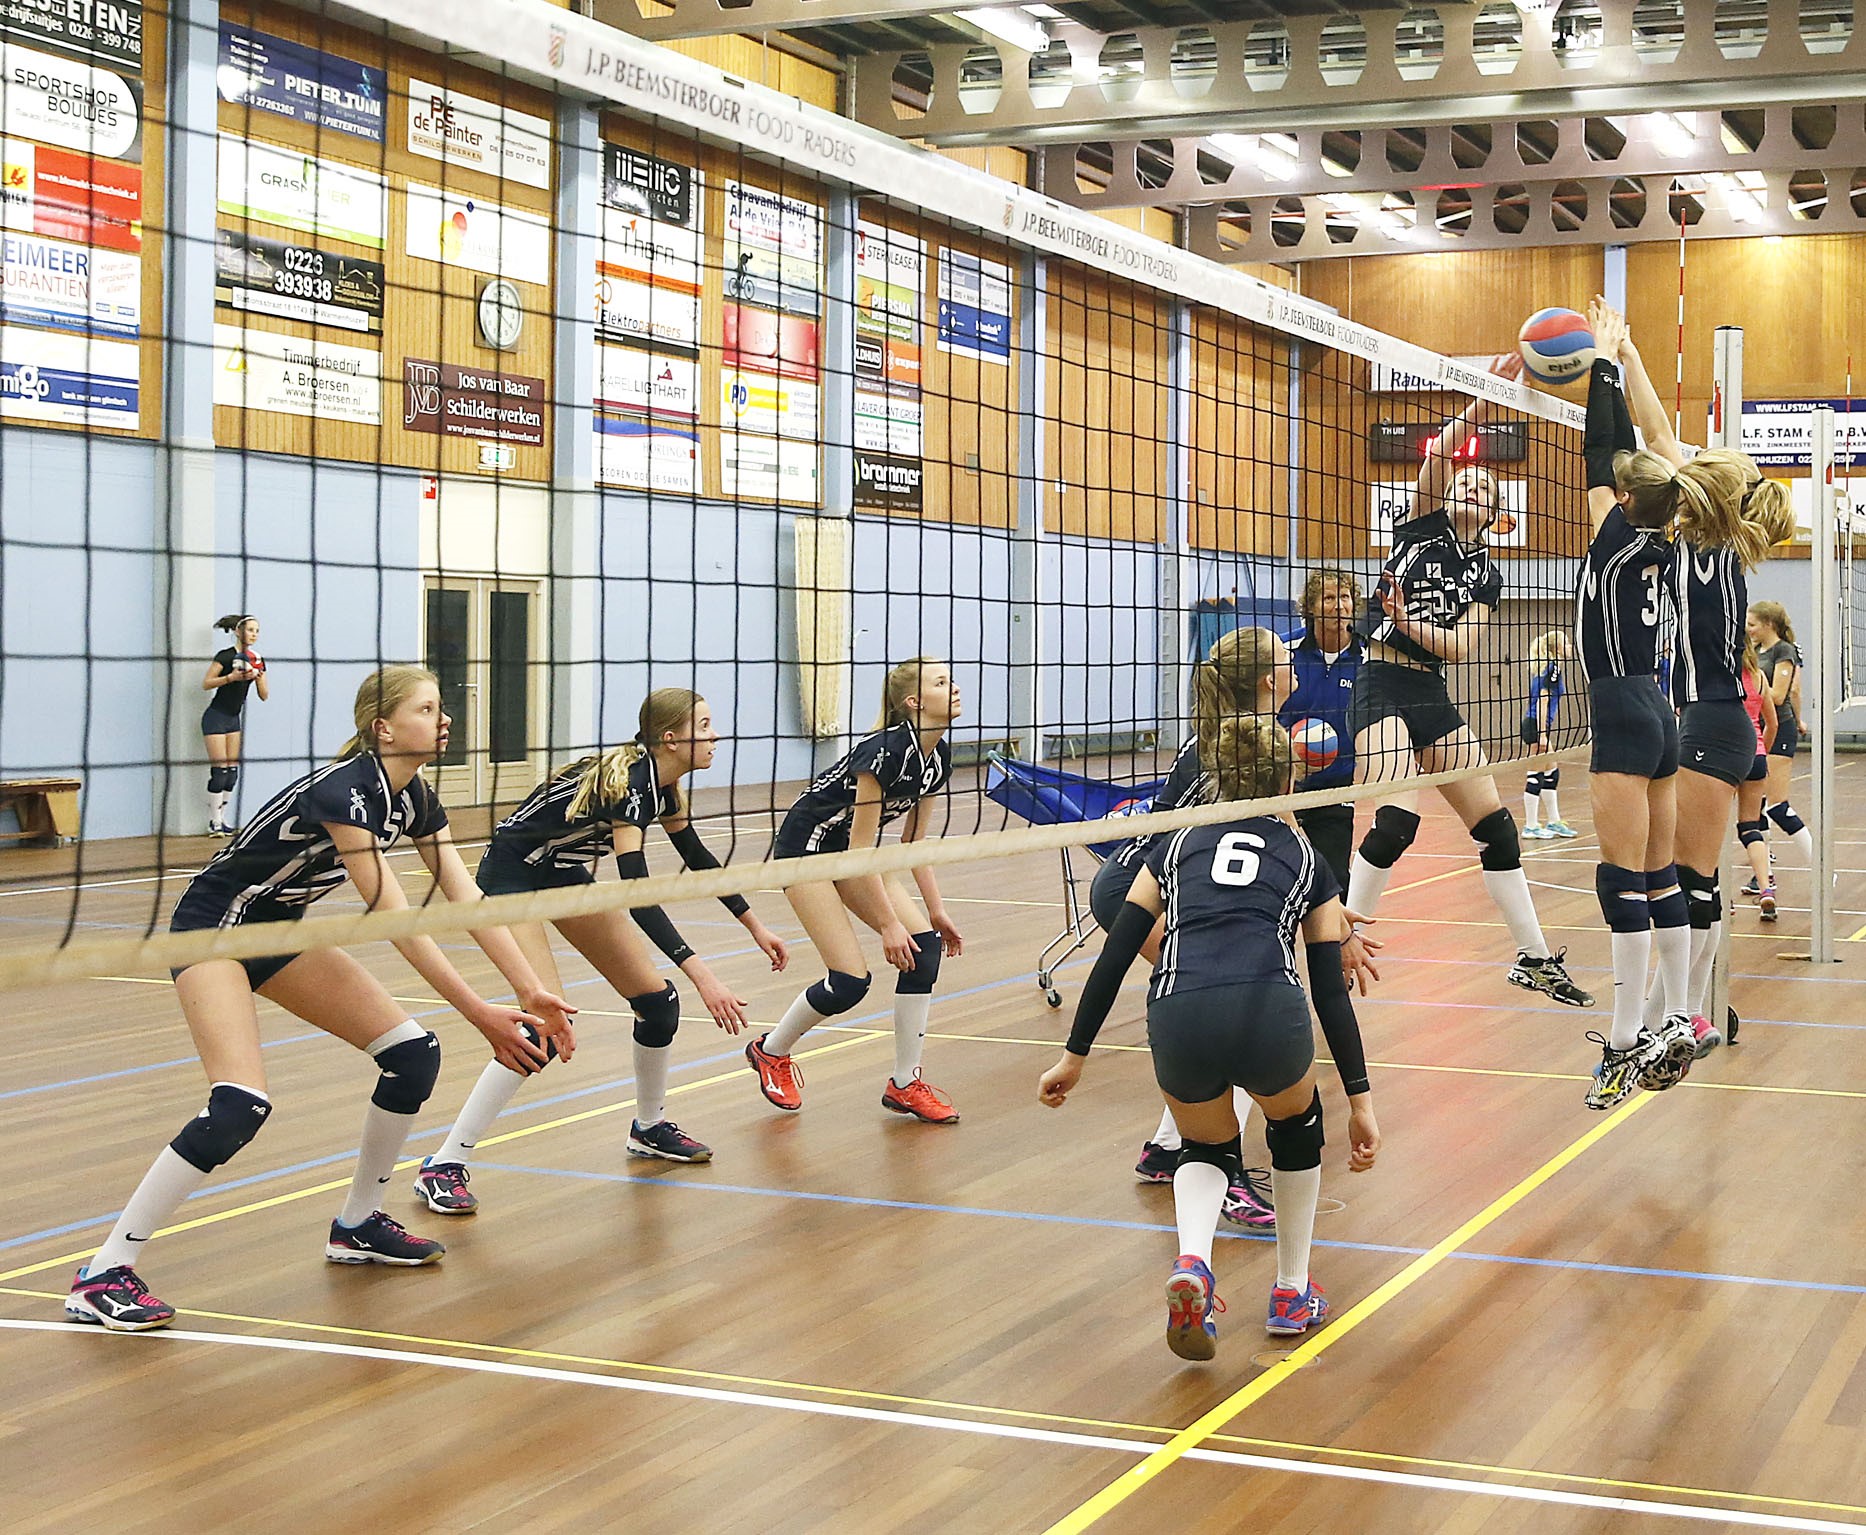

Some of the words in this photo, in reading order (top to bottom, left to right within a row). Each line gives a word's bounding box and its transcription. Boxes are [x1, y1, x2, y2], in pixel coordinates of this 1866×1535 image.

[69, 21, 94, 40] 0226
[14, 68, 118, 107] SPORTSHOP
[284, 74, 341, 105] PIETER
[48, 96, 117, 127] BOUWES
[747, 107, 793, 144] FOOD
[413, 112, 430, 131] de
[435, 118, 483, 147] Painter
[730, 185, 807, 221] Caravanbedrijf
[284, 247, 324, 276] 0226
[274, 271, 332, 302] 393938
[283, 348, 361, 376] Timmerbedrijf
[298, 372, 350, 393] Broersen
[458, 372, 476, 389] Jos
[479, 377, 502, 393] van
[504, 380, 530, 397] Baar
[447, 398, 540, 426] Schilderwerken
[1767, 427, 1803, 438] STAM
[1641, 563, 1660, 626] 3
[919, 767, 935, 795] 9
[1210, 831, 1266, 887] 6
